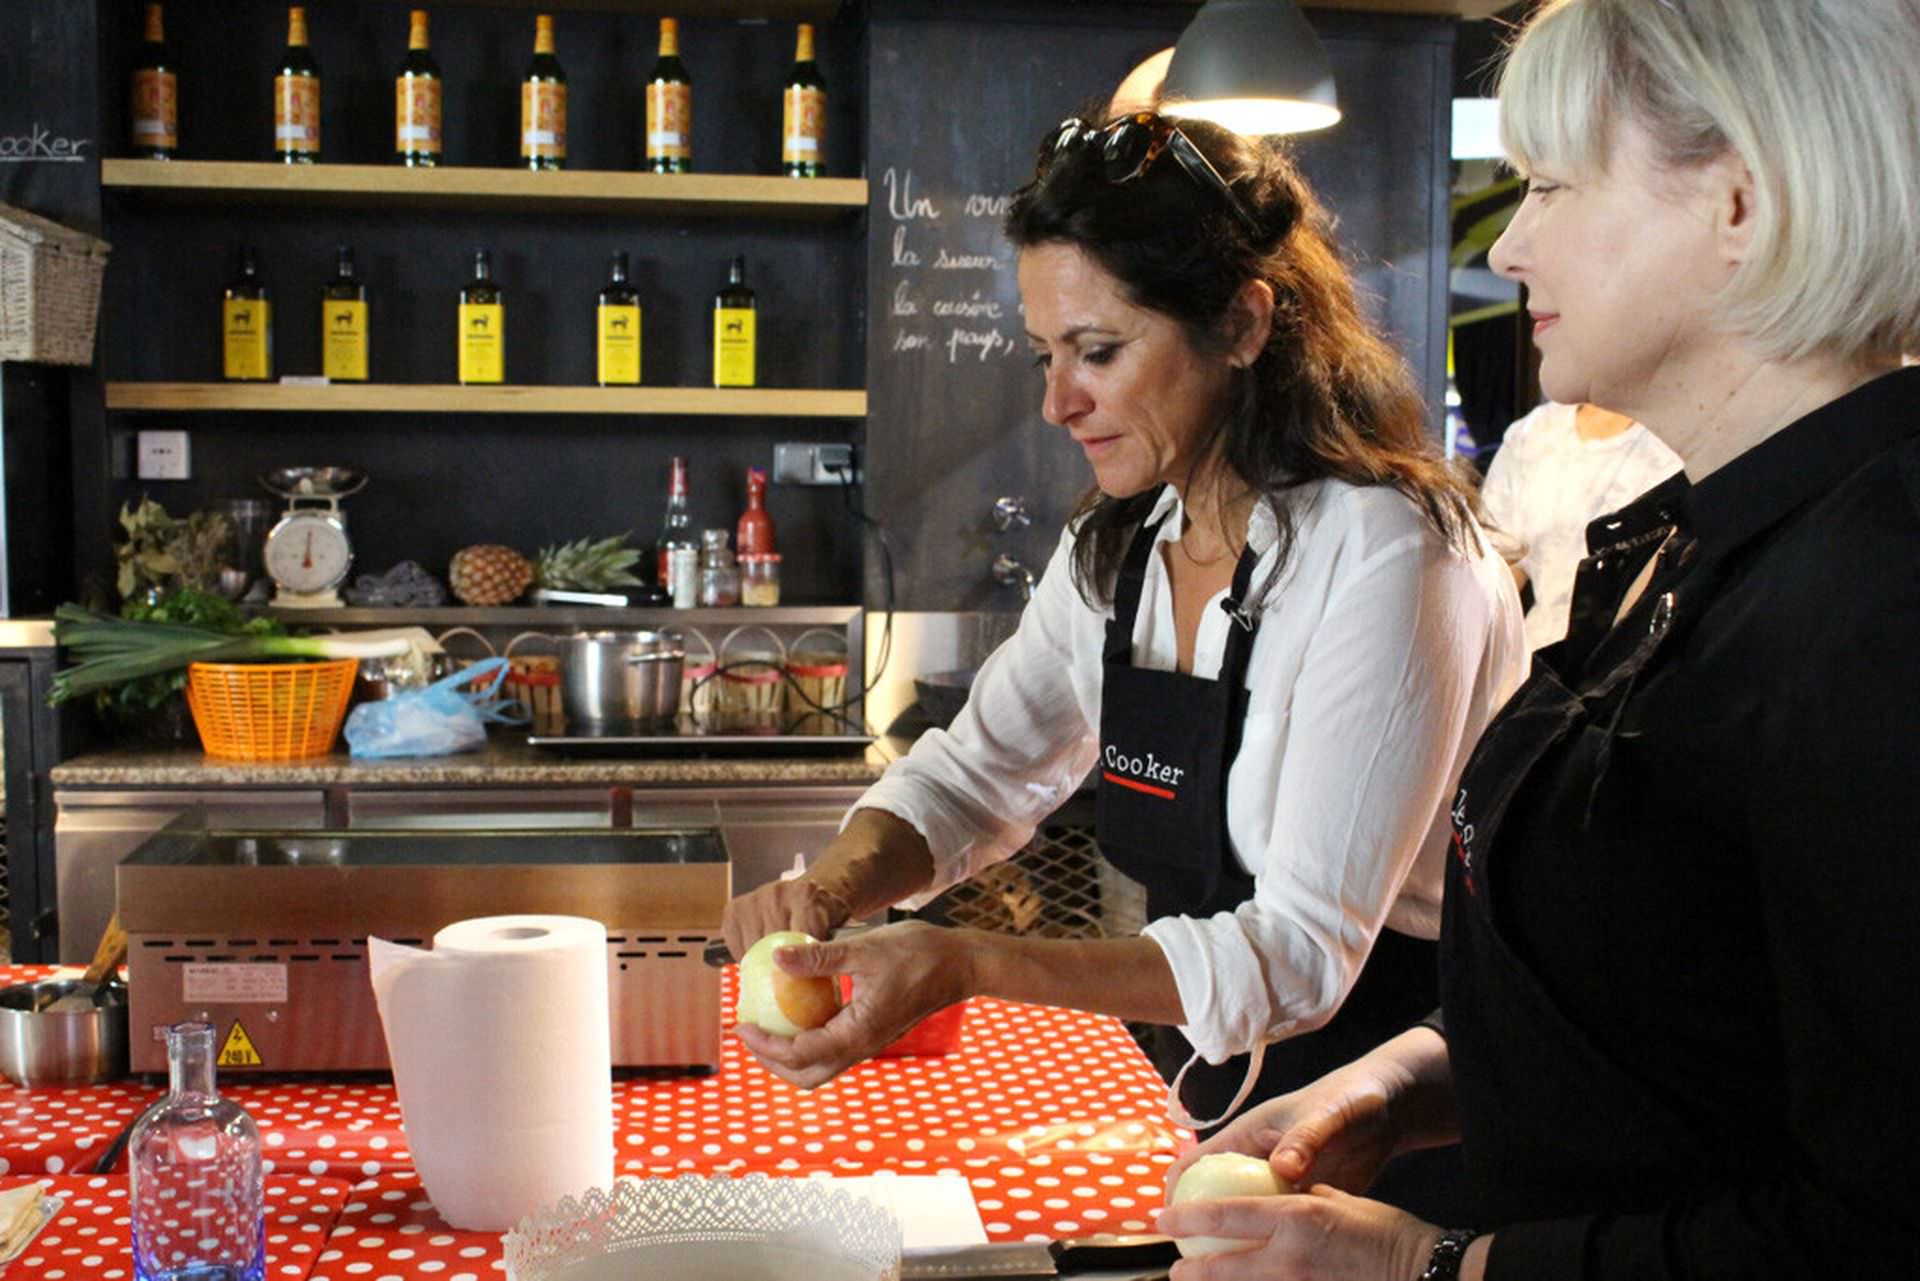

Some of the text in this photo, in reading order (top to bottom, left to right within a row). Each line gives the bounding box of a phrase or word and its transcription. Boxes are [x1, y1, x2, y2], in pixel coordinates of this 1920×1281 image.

[883, 168, 940, 219] Un
[892, 225, 920, 267] la
[894, 280, 917, 316] la
[1105, 745, 1184, 785] Cooker
